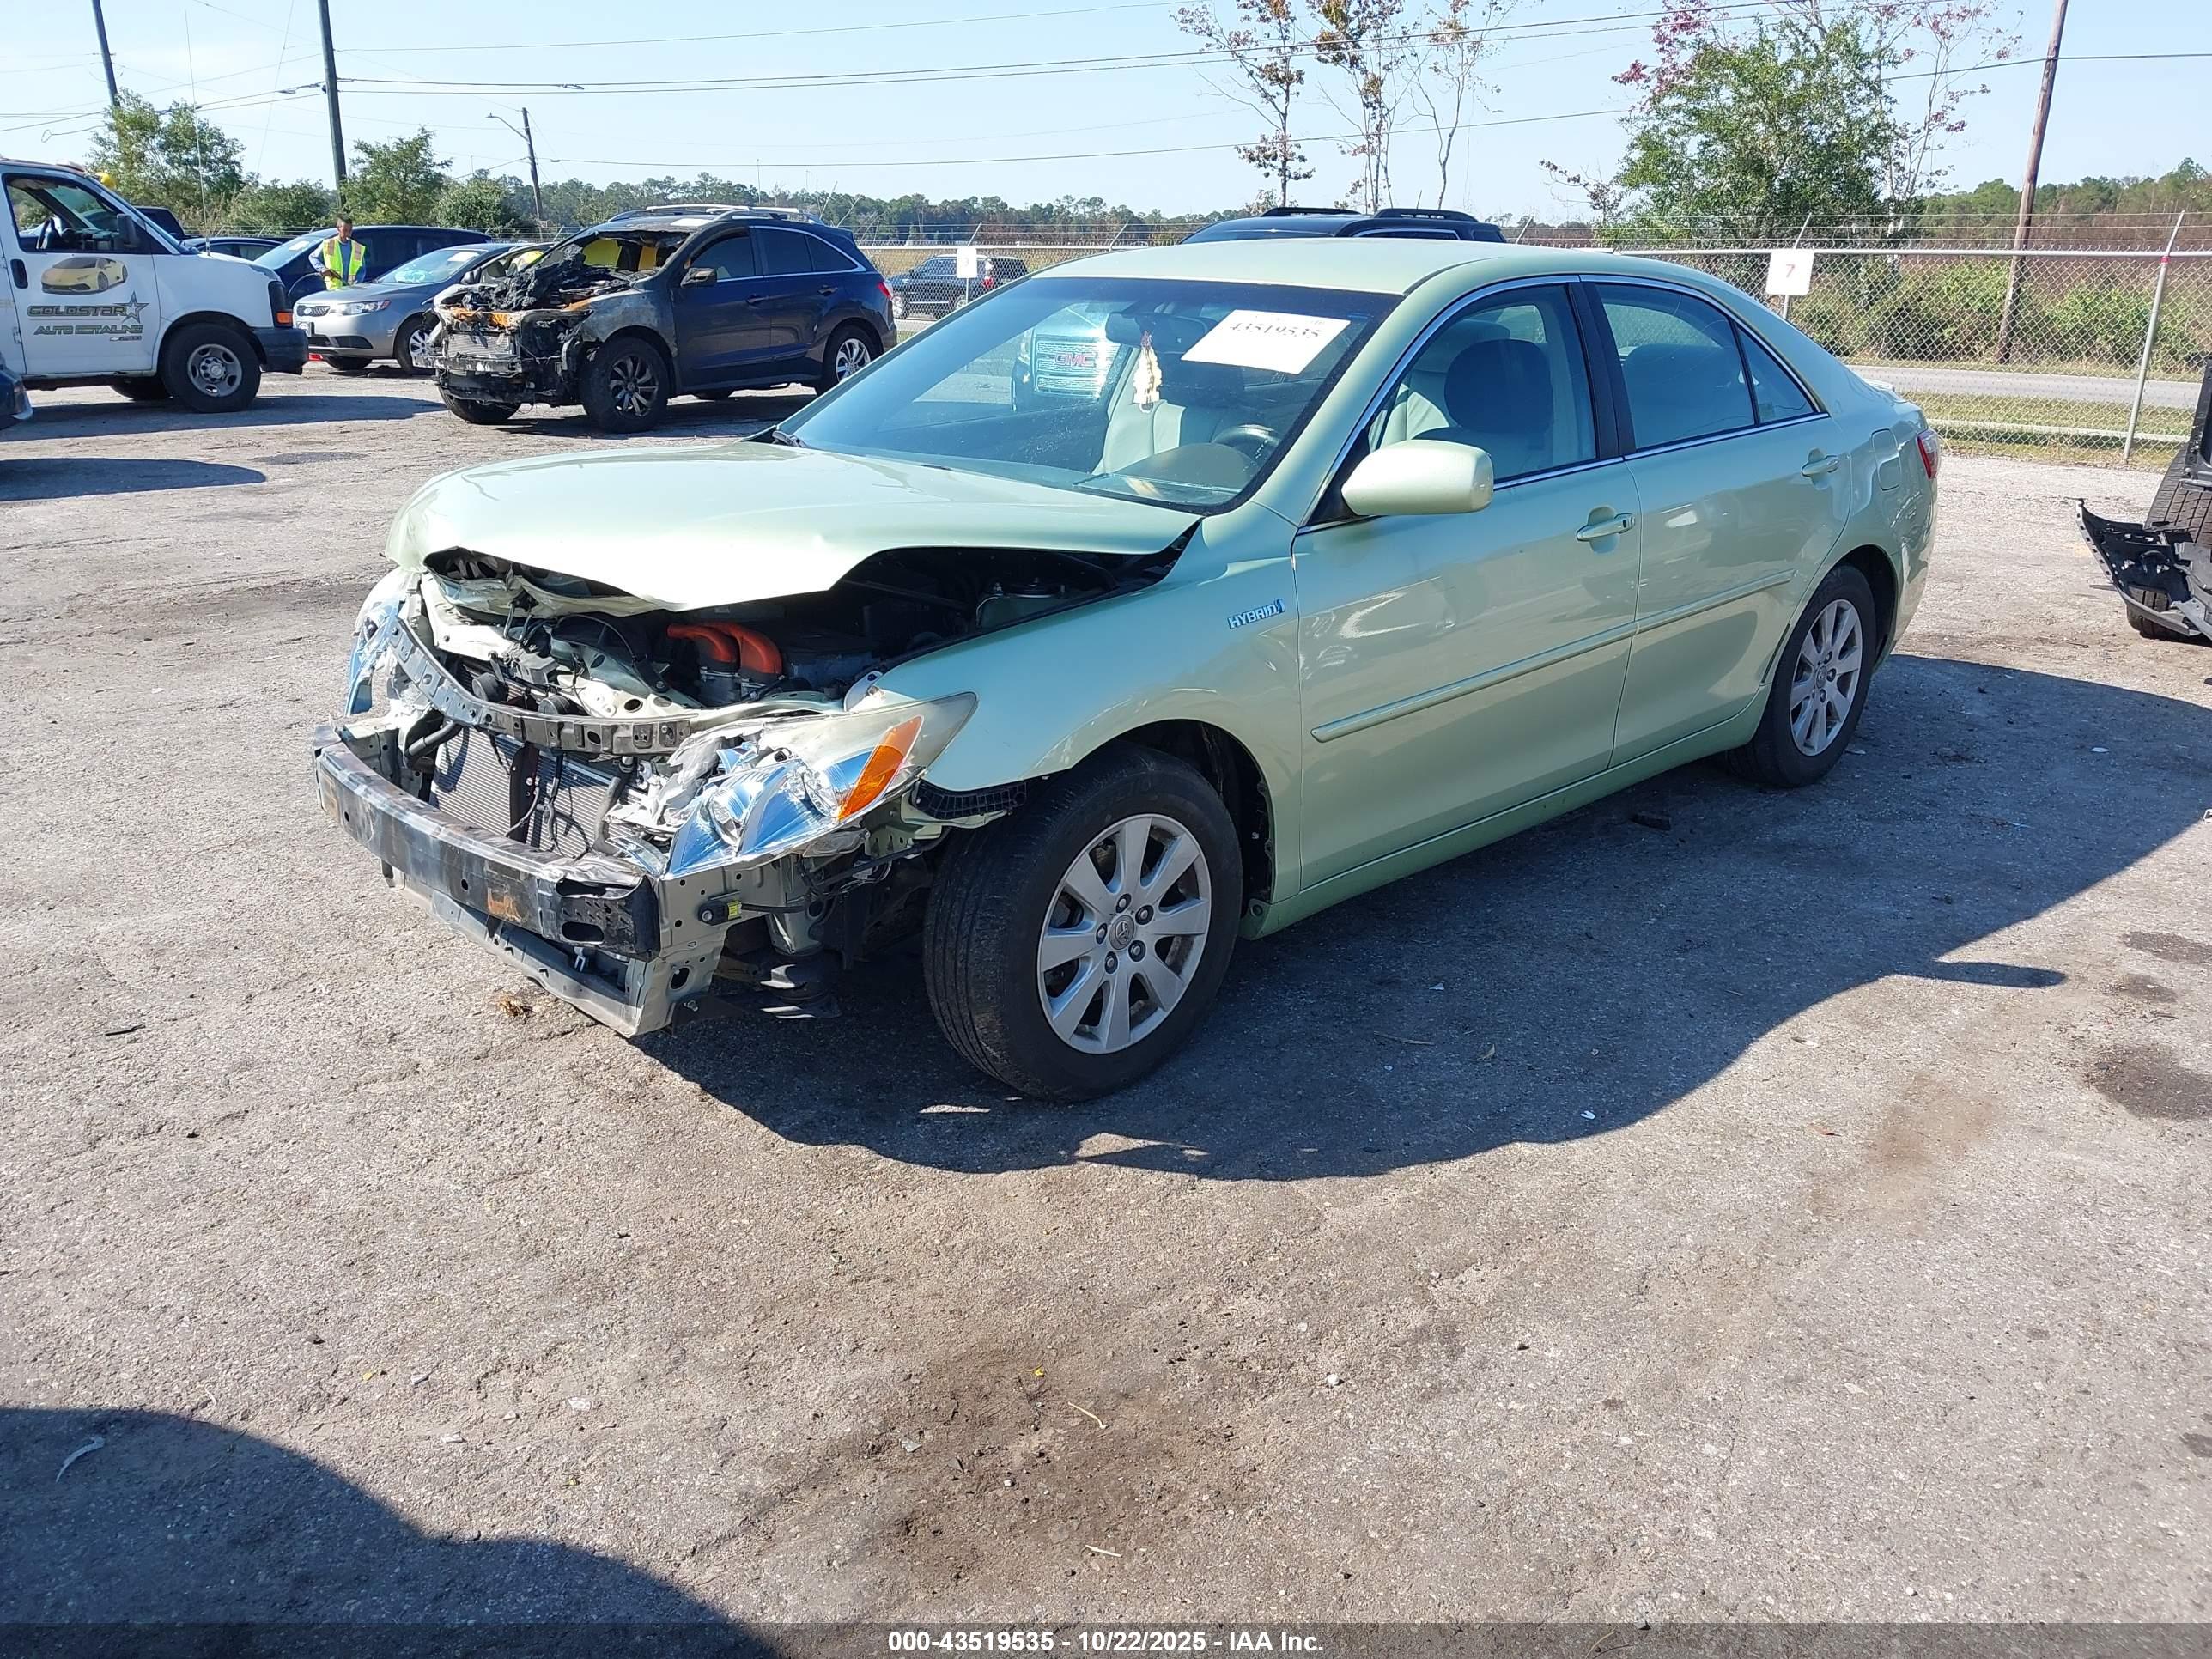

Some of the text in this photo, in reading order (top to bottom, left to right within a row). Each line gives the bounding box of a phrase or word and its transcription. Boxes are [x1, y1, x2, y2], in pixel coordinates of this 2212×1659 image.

[1785, 264, 1796, 278] 7
[27, 305, 127, 317] GOLDSTAR
[33, 325, 74, 336] AUTO
[1054, 352, 1097, 368] GMC
[1227, 604, 1278, 629] HYBRID
